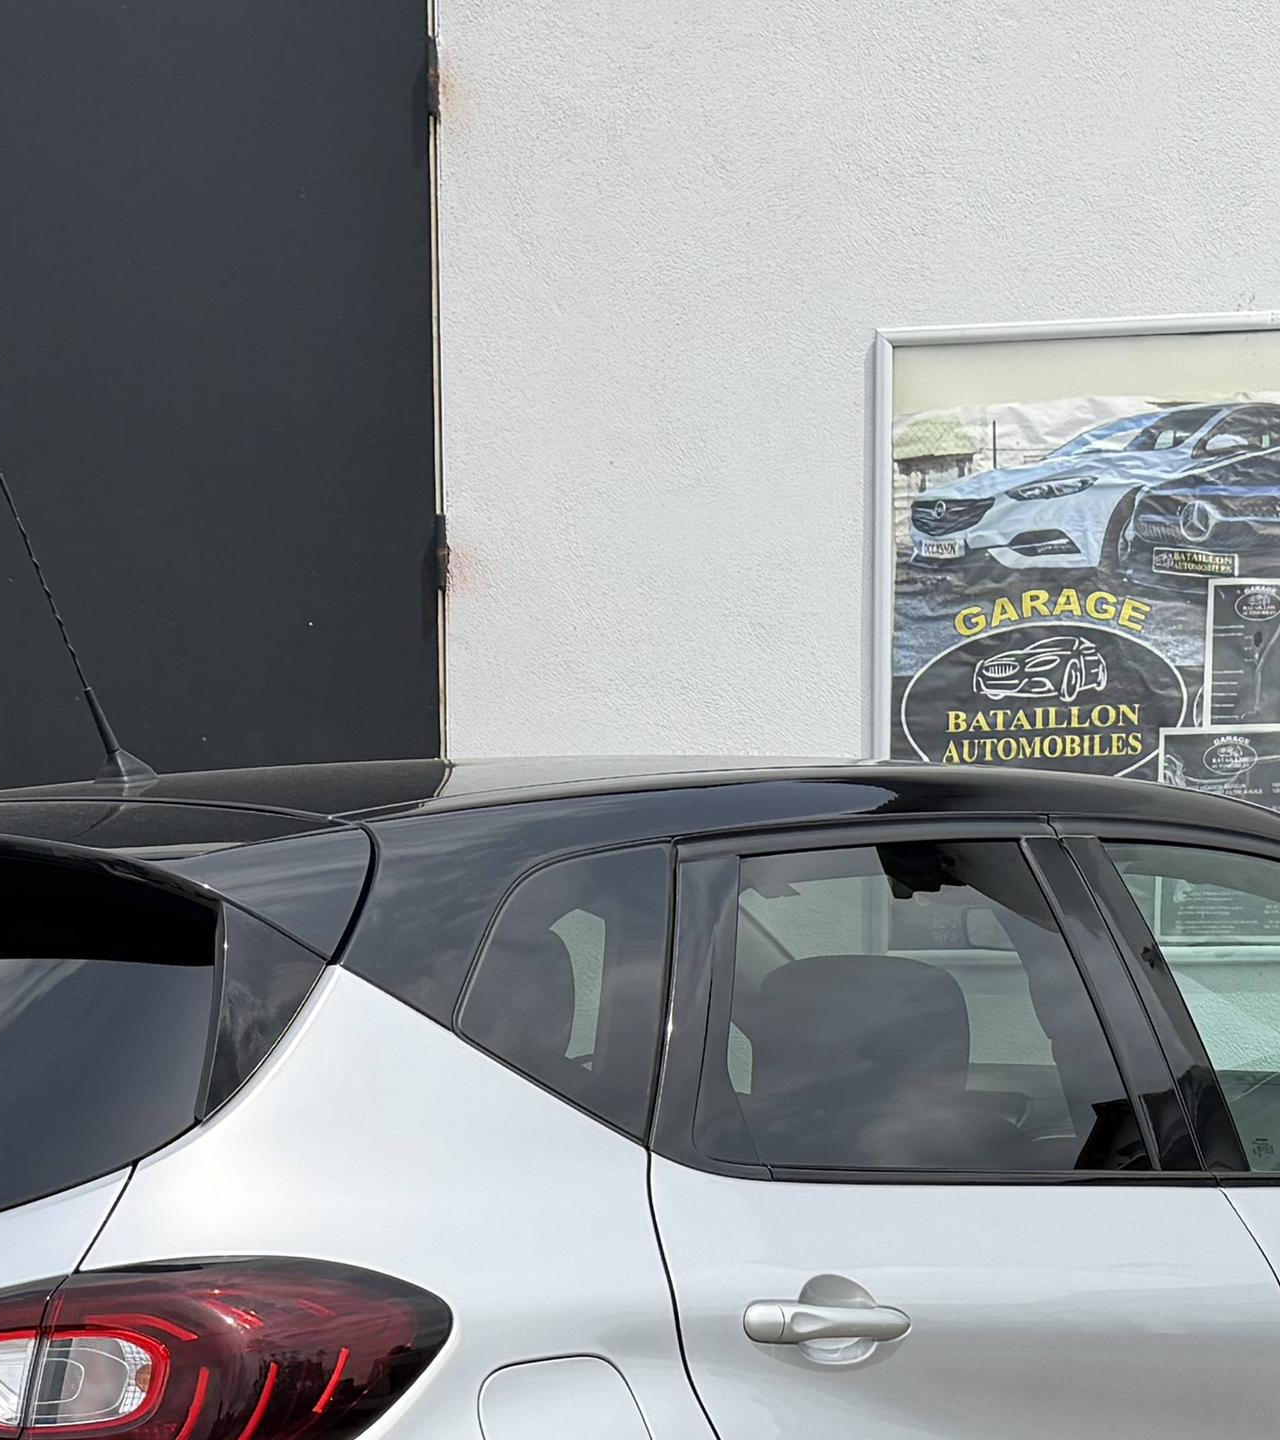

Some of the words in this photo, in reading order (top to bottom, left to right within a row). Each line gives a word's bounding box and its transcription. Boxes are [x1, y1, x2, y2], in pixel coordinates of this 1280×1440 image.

[1173, 552, 1233, 565] BATAILLON
[954, 587, 1152, 637] GARAGE
[946, 703, 1141, 733] BATAILLON
[942, 732, 1143, 763] AUTOMOBILES
